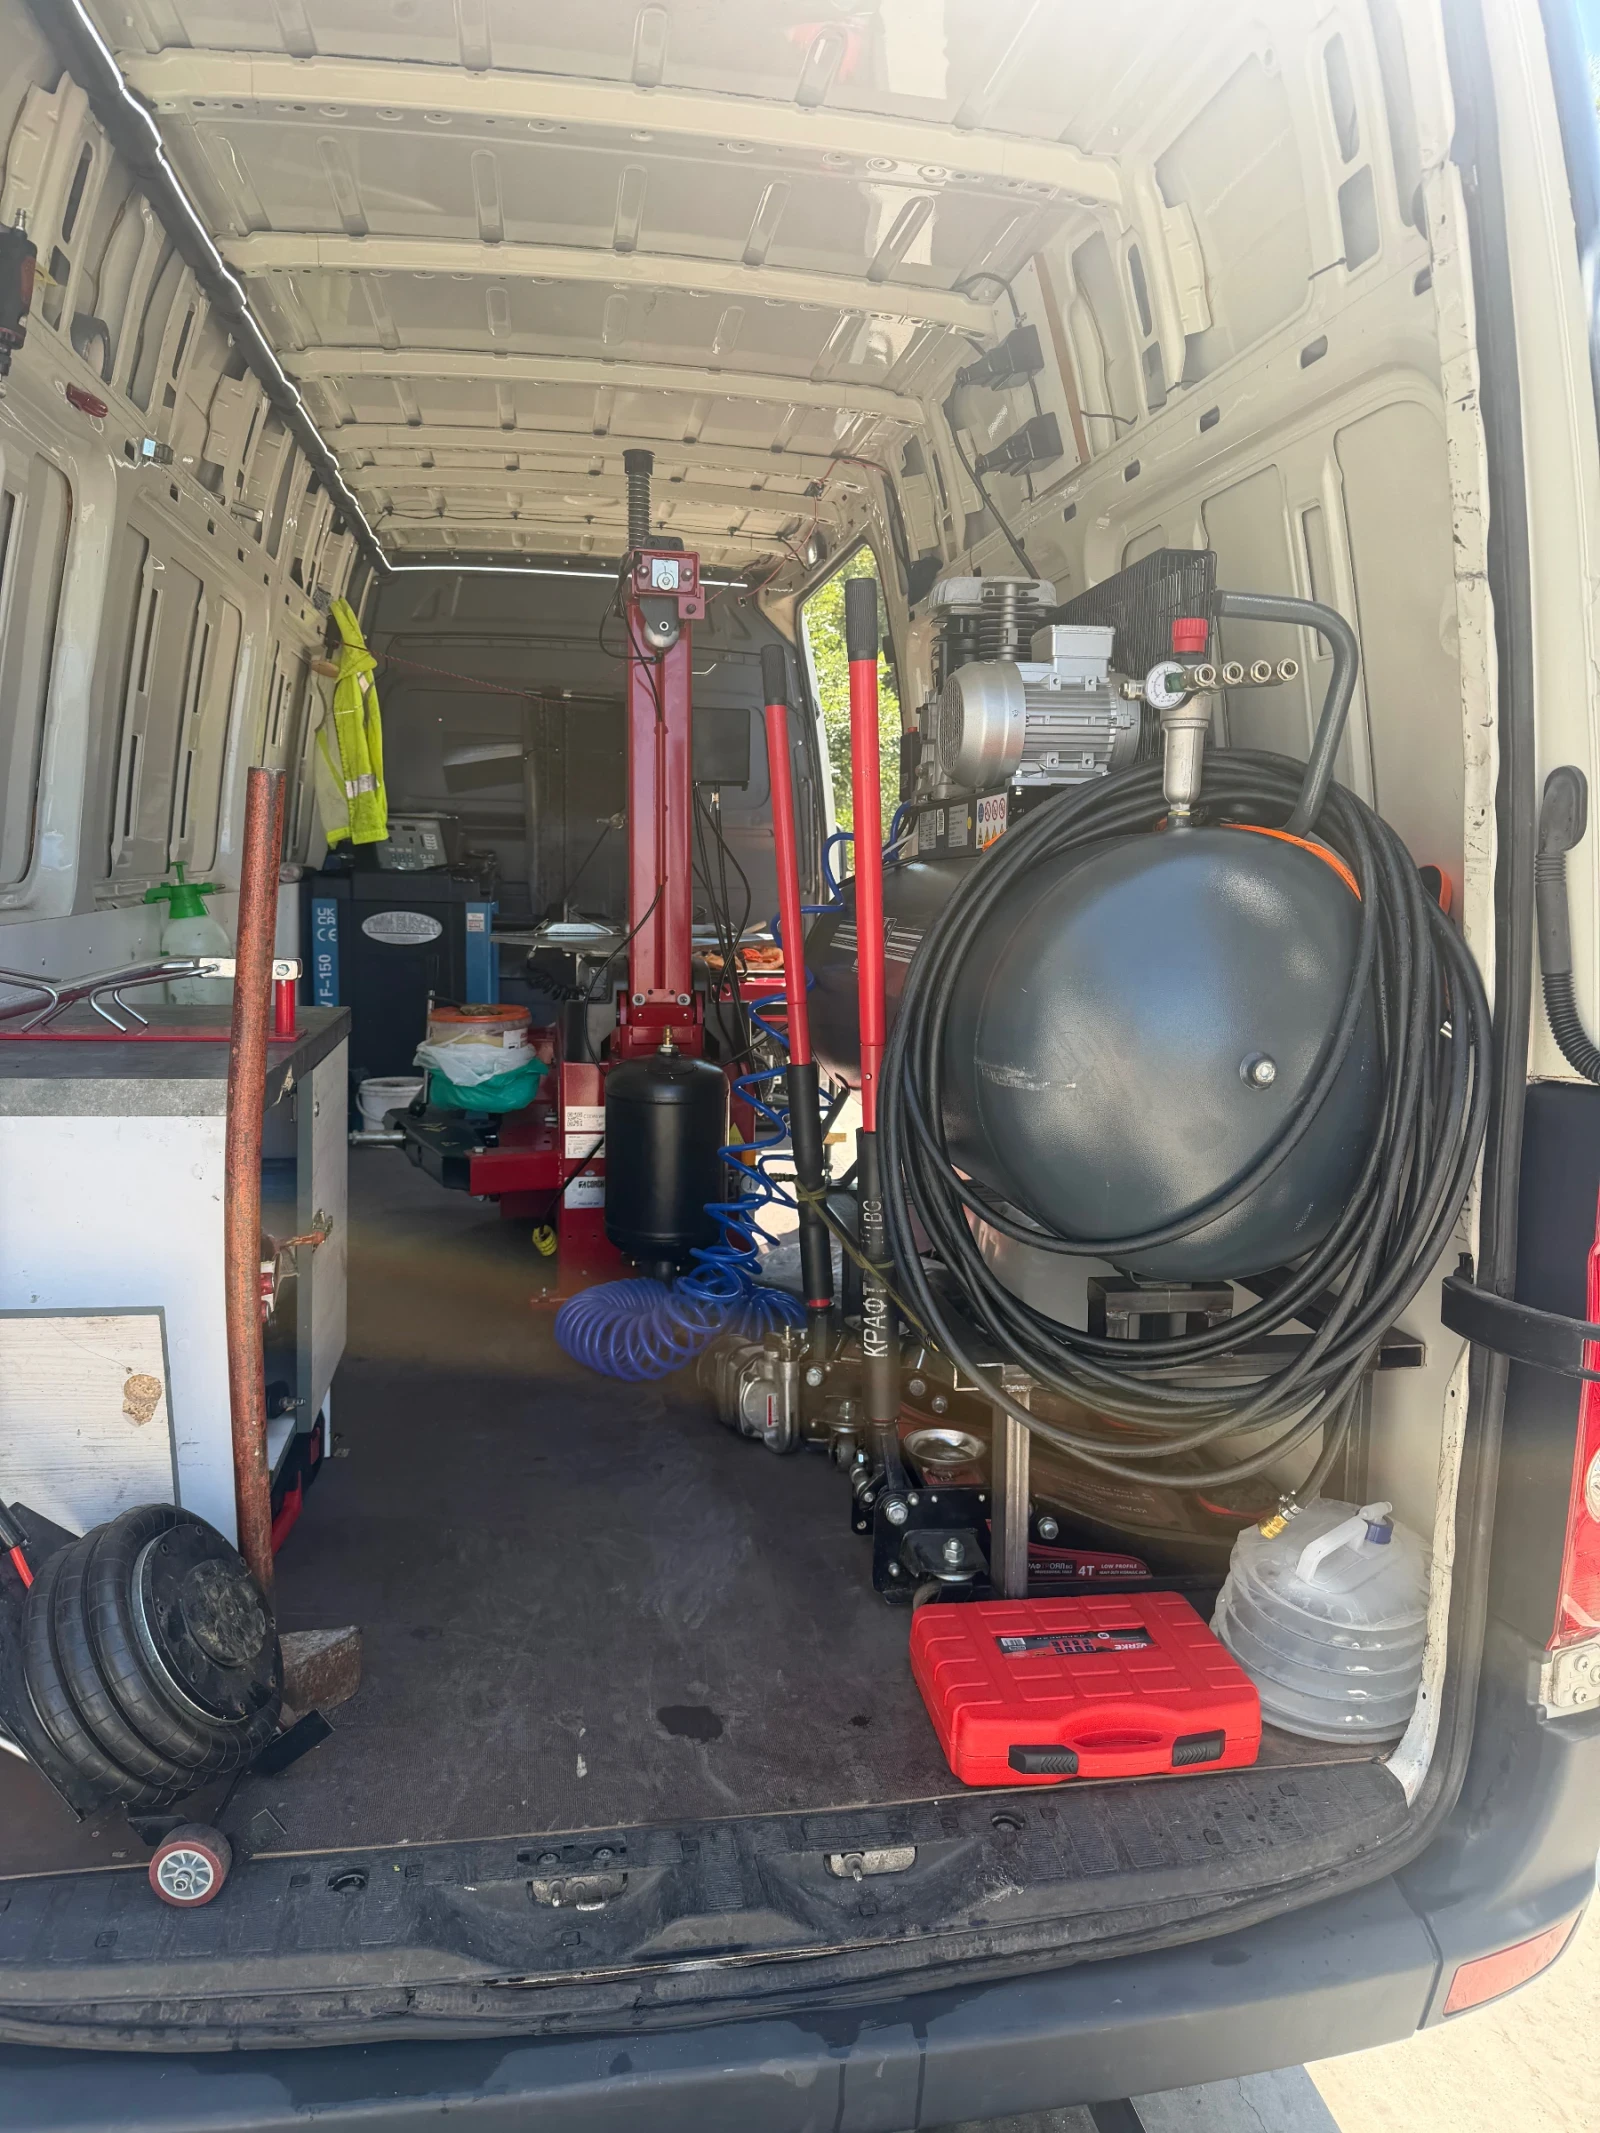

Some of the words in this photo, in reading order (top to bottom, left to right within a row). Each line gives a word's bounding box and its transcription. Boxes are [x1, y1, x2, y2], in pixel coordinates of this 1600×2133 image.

[316, 928, 338, 942] CE
[318, 954, 334, 997] F-150
[1078, 1565, 1095, 1576] 4T
